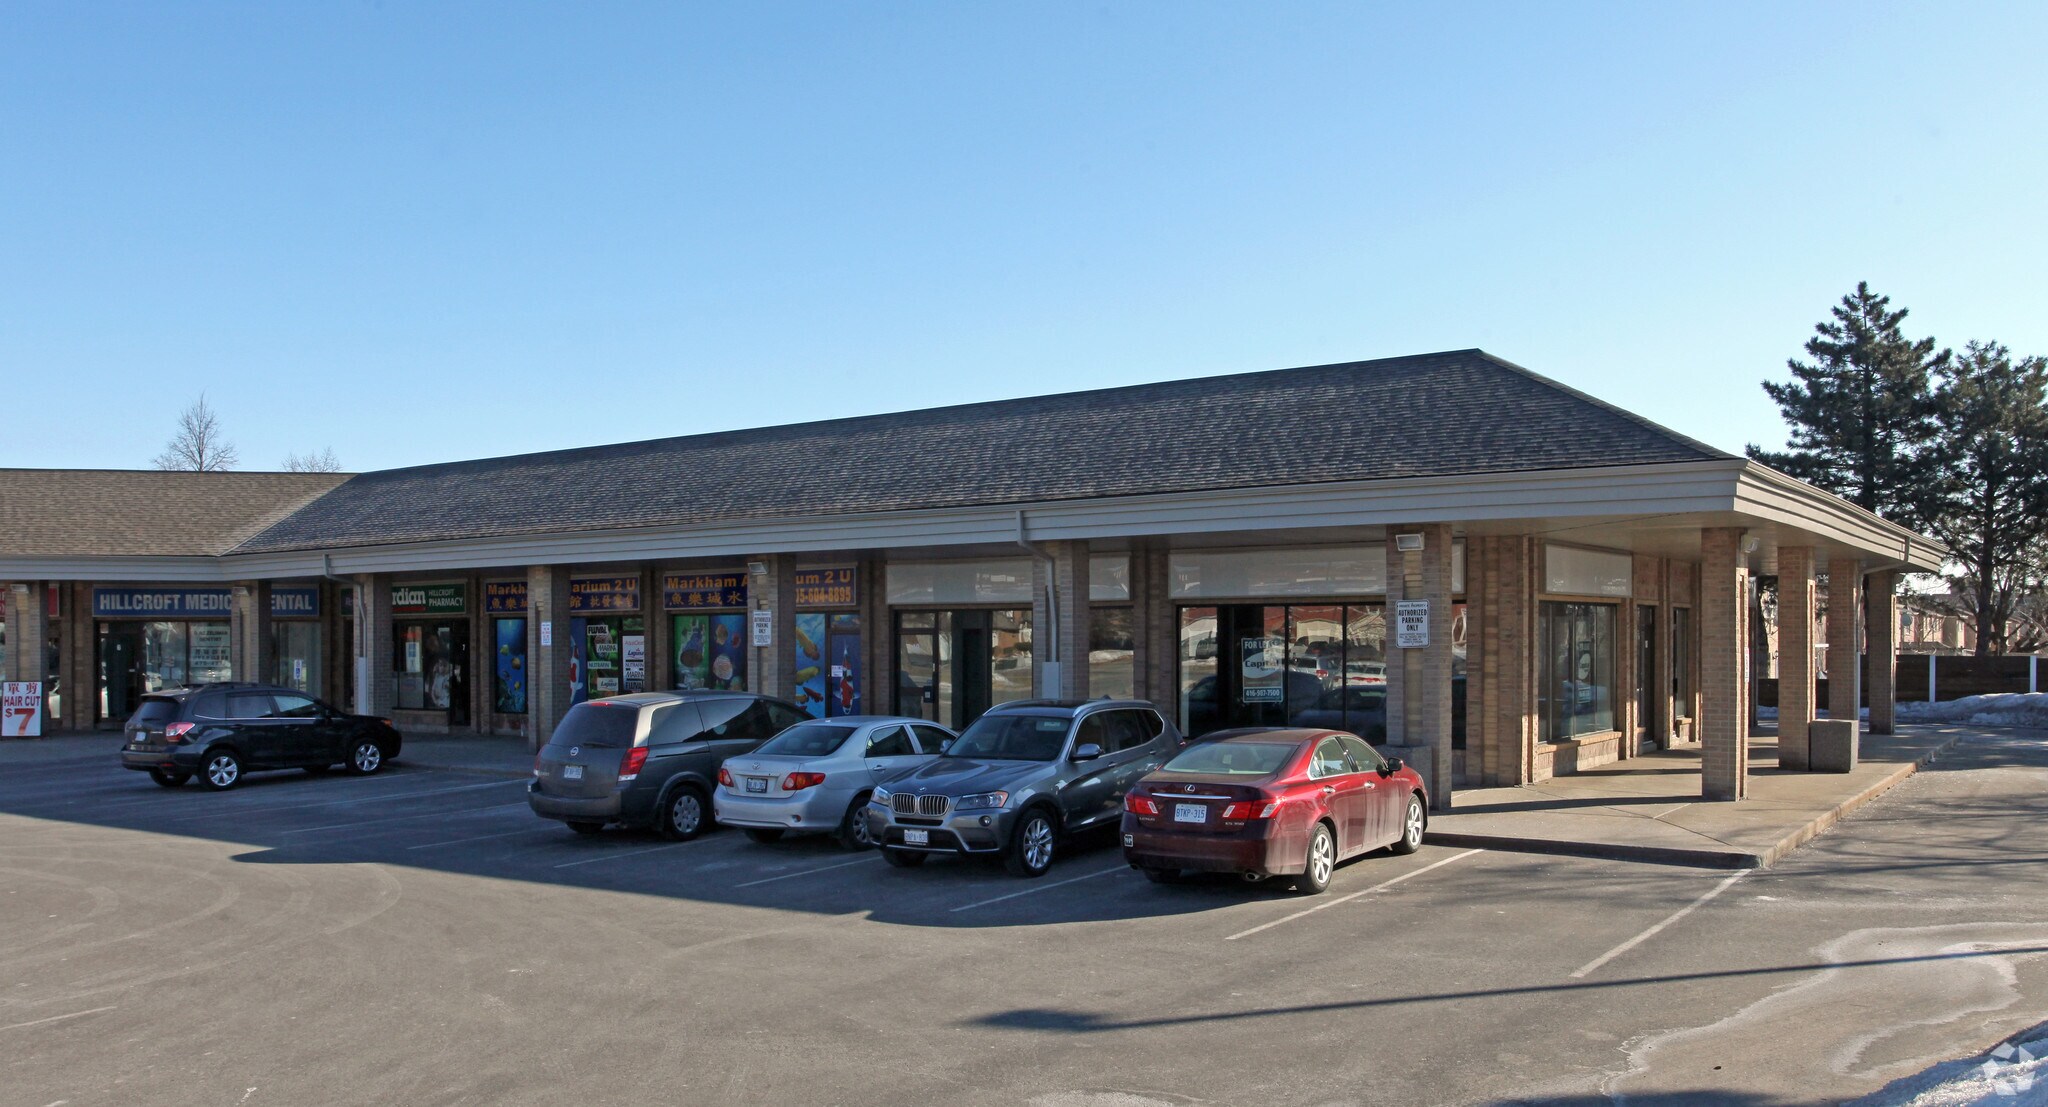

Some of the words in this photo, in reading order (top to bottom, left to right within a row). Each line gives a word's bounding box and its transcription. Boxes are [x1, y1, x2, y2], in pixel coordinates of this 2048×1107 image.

[667, 575, 737, 589] Markham
[824, 570, 834, 584] 2
[839, 569, 851, 583] U
[572, 580, 611, 593] arium
[614, 579, 623, 591] 2
[625, 578, 636, 591] U
[428, 588, 455, 597] HILLCROFT
[100, 594, 180, 610] HILLCROFT
[185, 594, 232, 610] MEDIC
[428, 597, 464, 607] PHARMACY
[1244, 640, 1258, 649] FOR
[4, 695, 23, 706] HAIR
[24, 695, 41, 706] CUT
